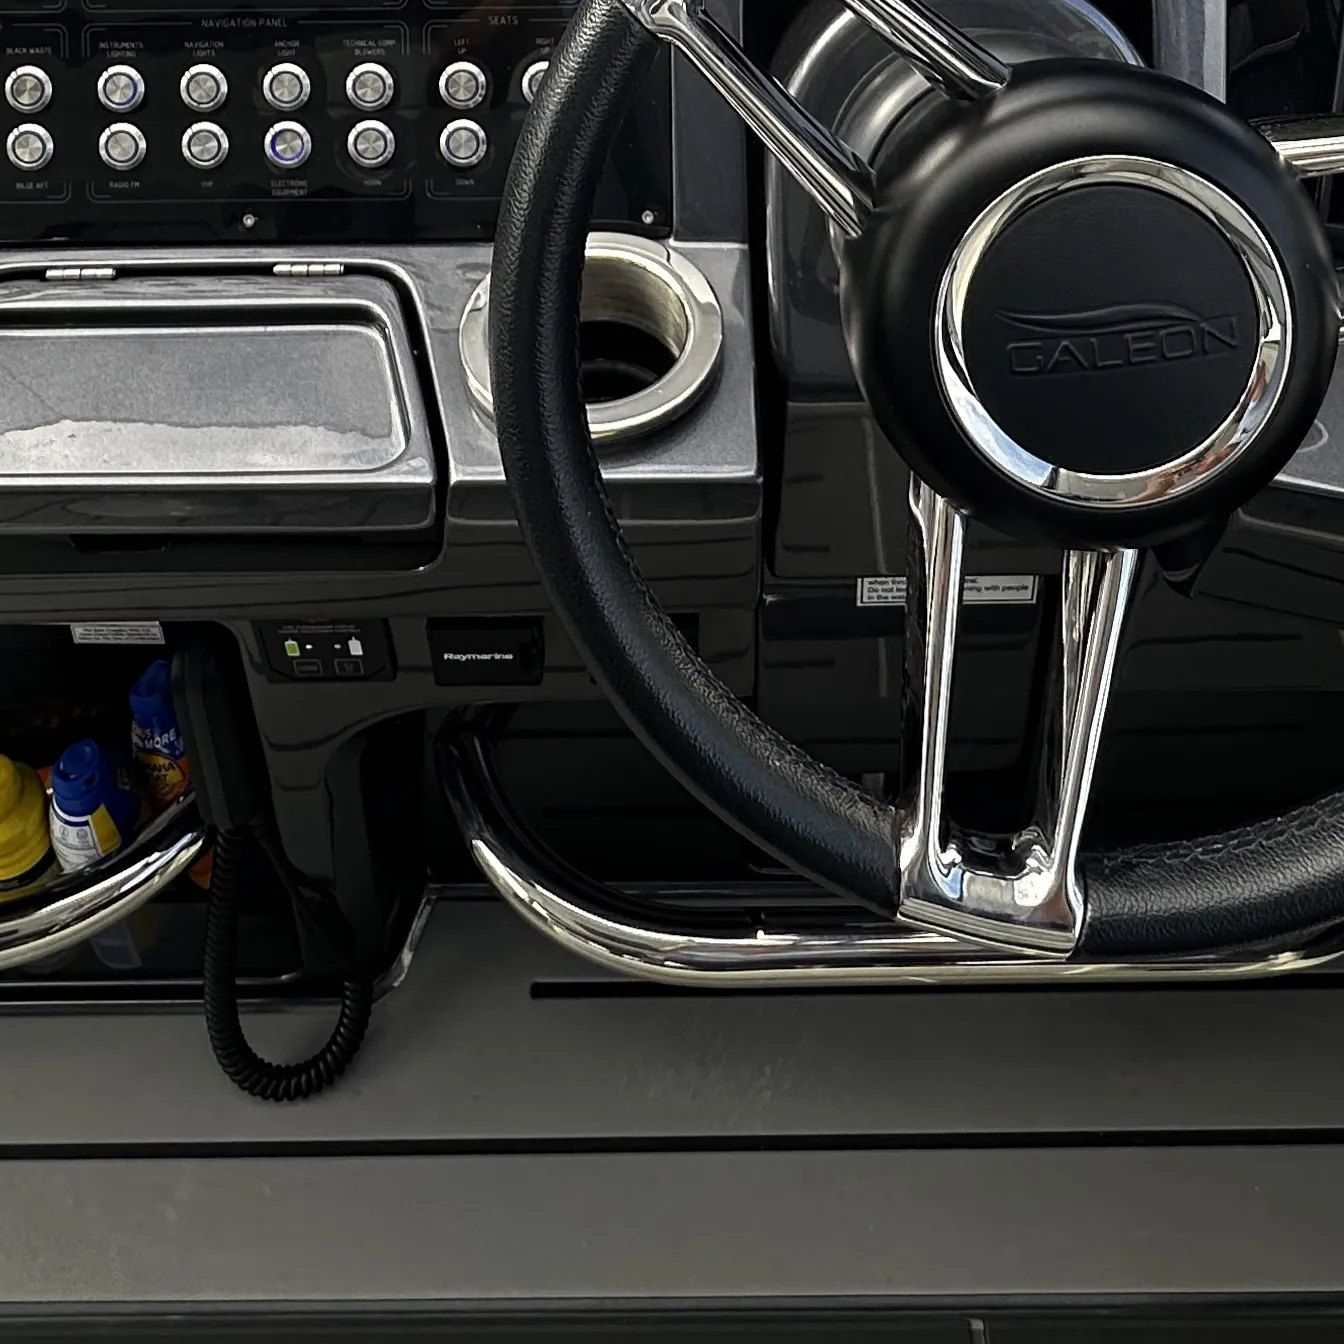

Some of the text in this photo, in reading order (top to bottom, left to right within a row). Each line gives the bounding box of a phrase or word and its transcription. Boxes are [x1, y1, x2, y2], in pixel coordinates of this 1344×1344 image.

[201, 17, 288, 29] NAVIGATION PANEL
[488, 16, 519, 26] SEATS
[183, 40, 224, 49] NAVIGATION
[6, 46, 28, 55] BLACK
[1005, 316, 1242, 375] GALEON
[1001, 583, 1030, 593] people
[443, 651, 513, 662] Raymarine
